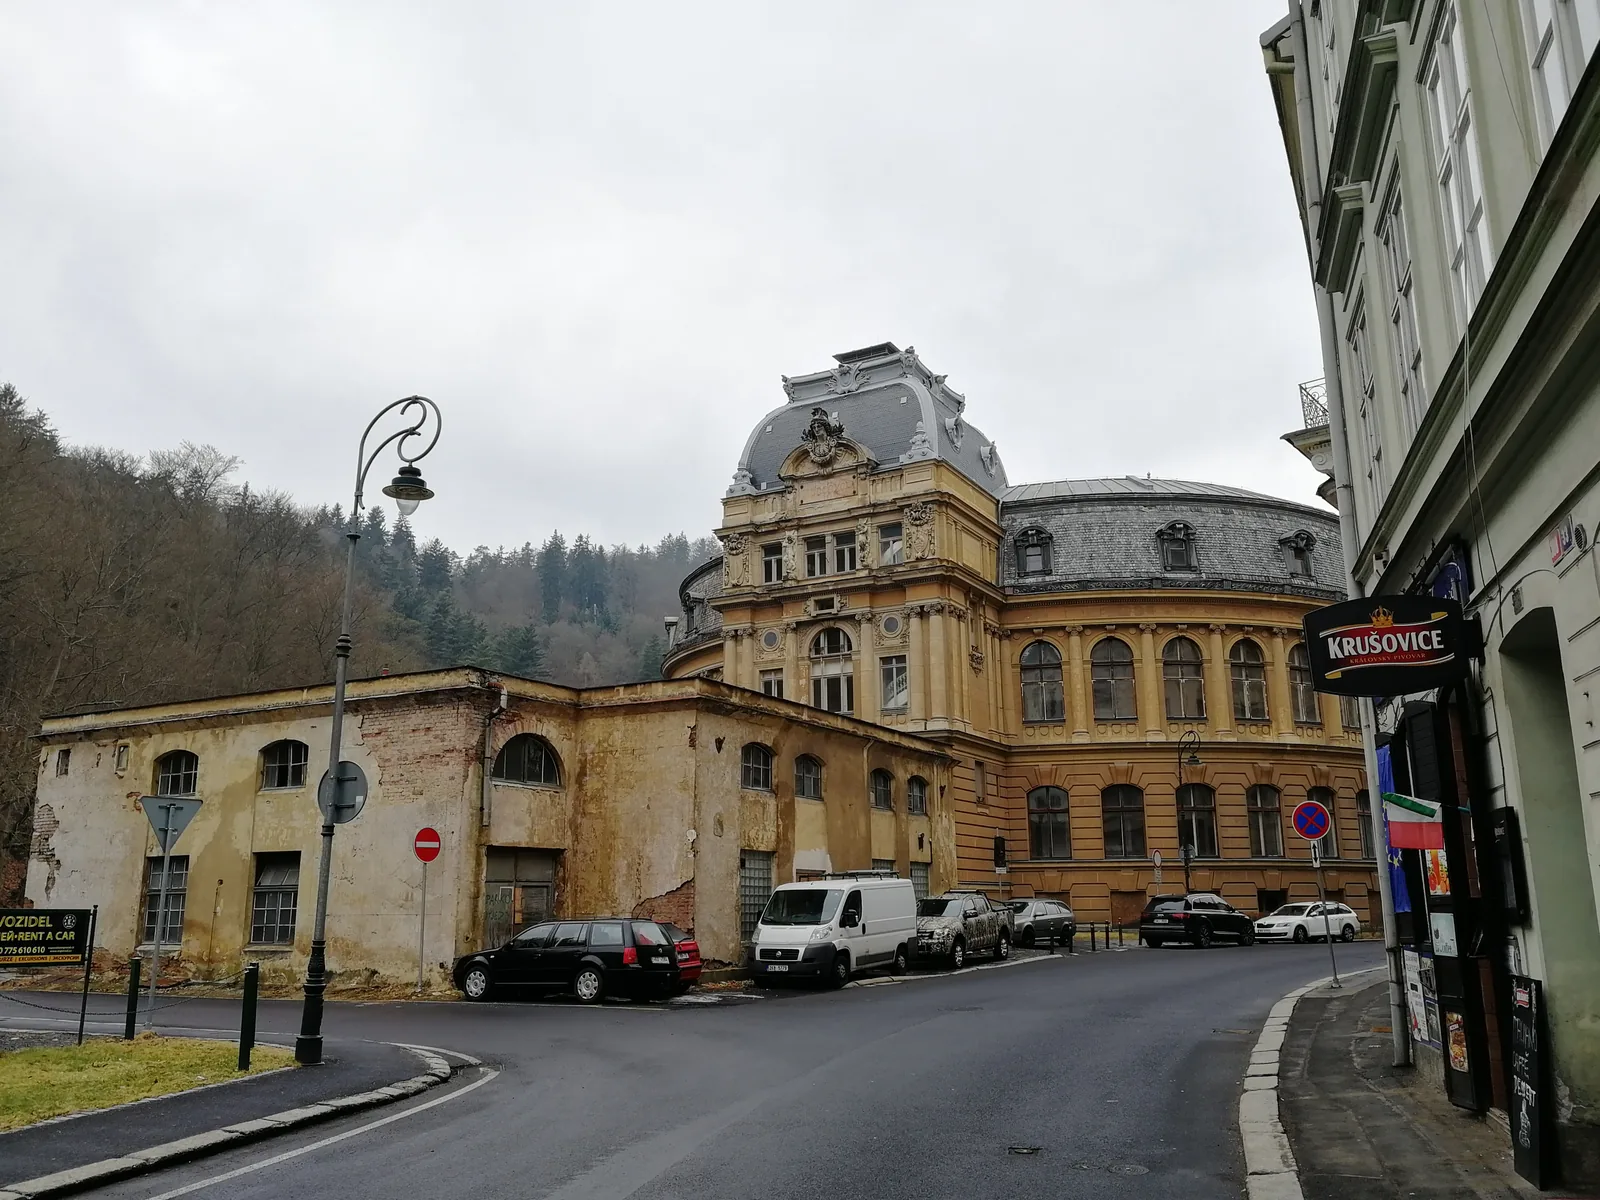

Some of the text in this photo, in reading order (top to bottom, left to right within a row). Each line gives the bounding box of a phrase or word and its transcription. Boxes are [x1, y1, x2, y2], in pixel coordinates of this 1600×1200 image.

[1327, 630, 1444, 659] KRUŠOVICE
[0, 916, 53, 927] VOZIDEL
[18, 931, 75, 941] RENT A CAR
[18, 946, 32, 954] 610
[32, 946, 45, 954] 610
